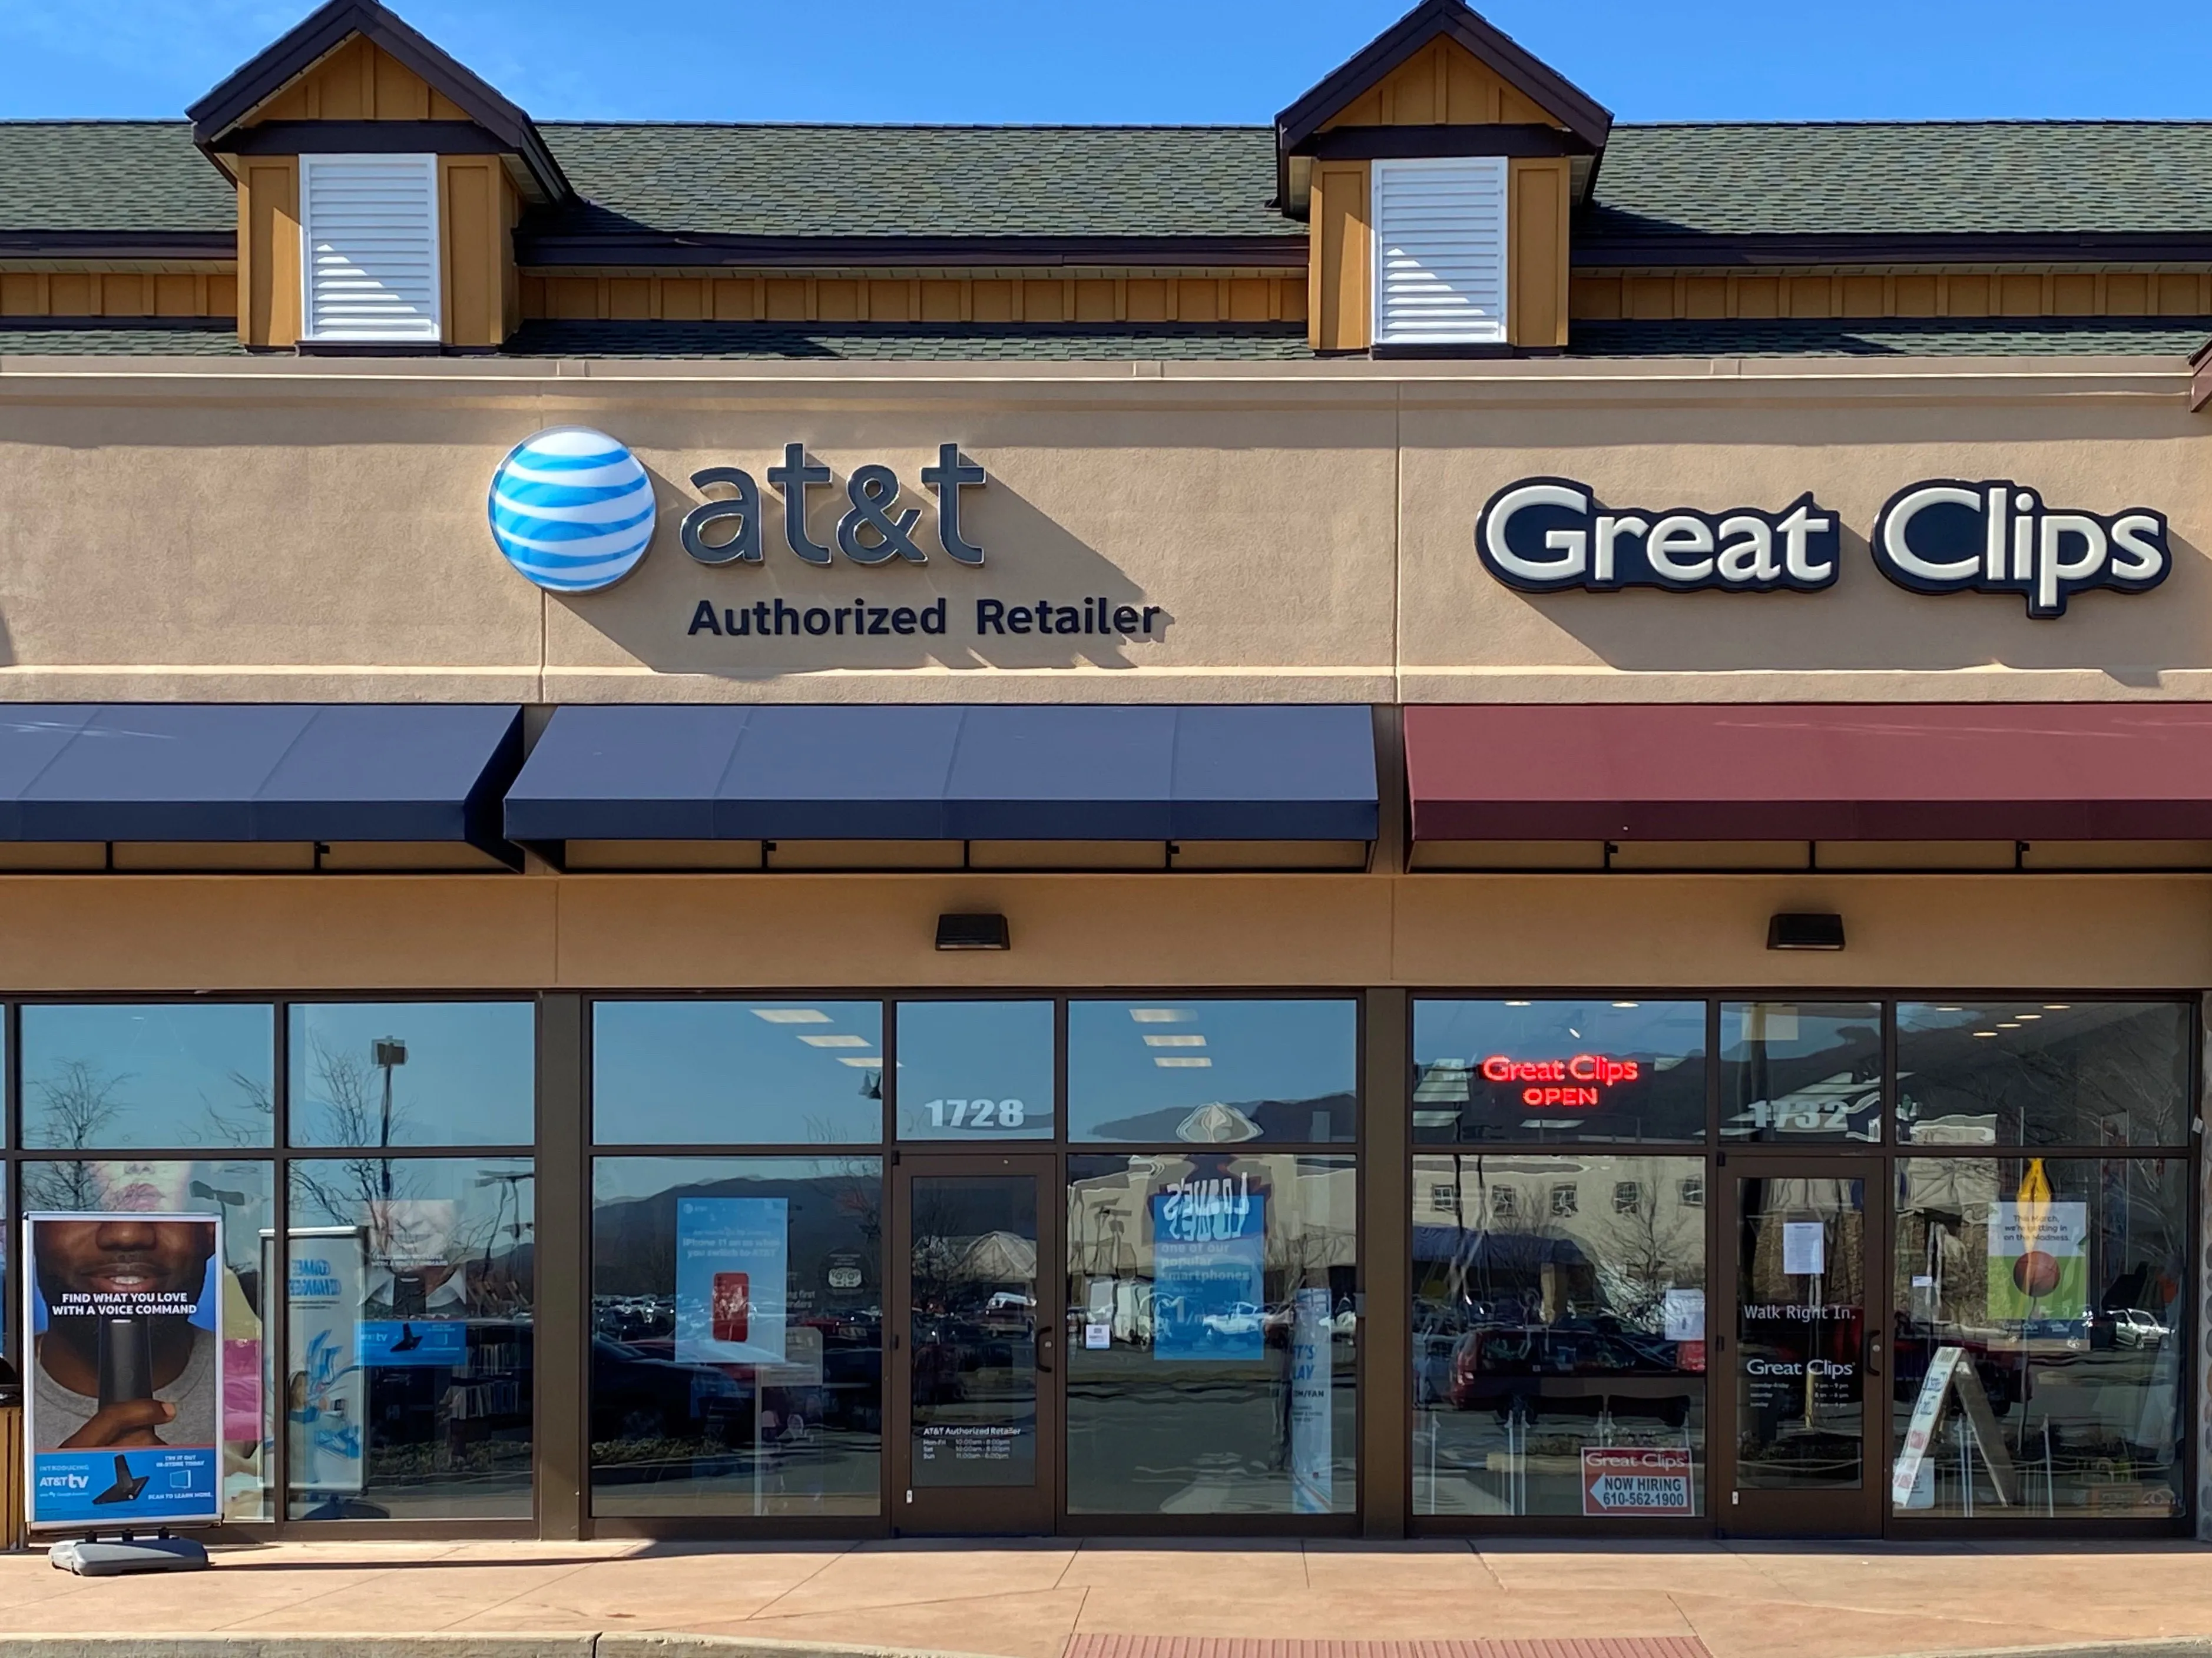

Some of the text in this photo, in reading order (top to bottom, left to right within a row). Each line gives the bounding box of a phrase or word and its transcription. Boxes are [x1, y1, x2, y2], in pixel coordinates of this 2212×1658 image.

[680, 443, 985, 566] at&t
[1486, 484, 2164, 608] Great Clips
[688, 598, 1160, 637] Authorized Retailer
[1483, 1055, 1638, 1087] Great Clips
[1523, 1087, 1598, 1106] OPEN
[924, 1099, 1024, 1128] 1728
[1747, 1100, 1849, 1129] 1732
[1188, 1243, 1204, 1254] of
[1207, 1244, 1230, 1254] our
[1161, 1256, 1213, 1269] popular
[1161, 1269, 1250, 1282] smartphones
[62, 1292, 188, 1304] FIND WHAT YOU LOVE
[52, 1304, 197, 1315] WITH A VOICE COMMAND
[1744, 1304, 1856, 1323] Walk Right In.
[1746, 1358, 1854, 1380] Great Clips
[923, 1427, 944, 1435] AT&T
[945, 1427, 990, 1435] Authorized
[1585, 1453, 1686, 1472] Great Clips
[39, 1473, 89, 1489] AT&T tv
[1605, 1477, 1682, 1492] NOW HIRING
[1602, 1492, 1684, 1507] 610-562-1900
